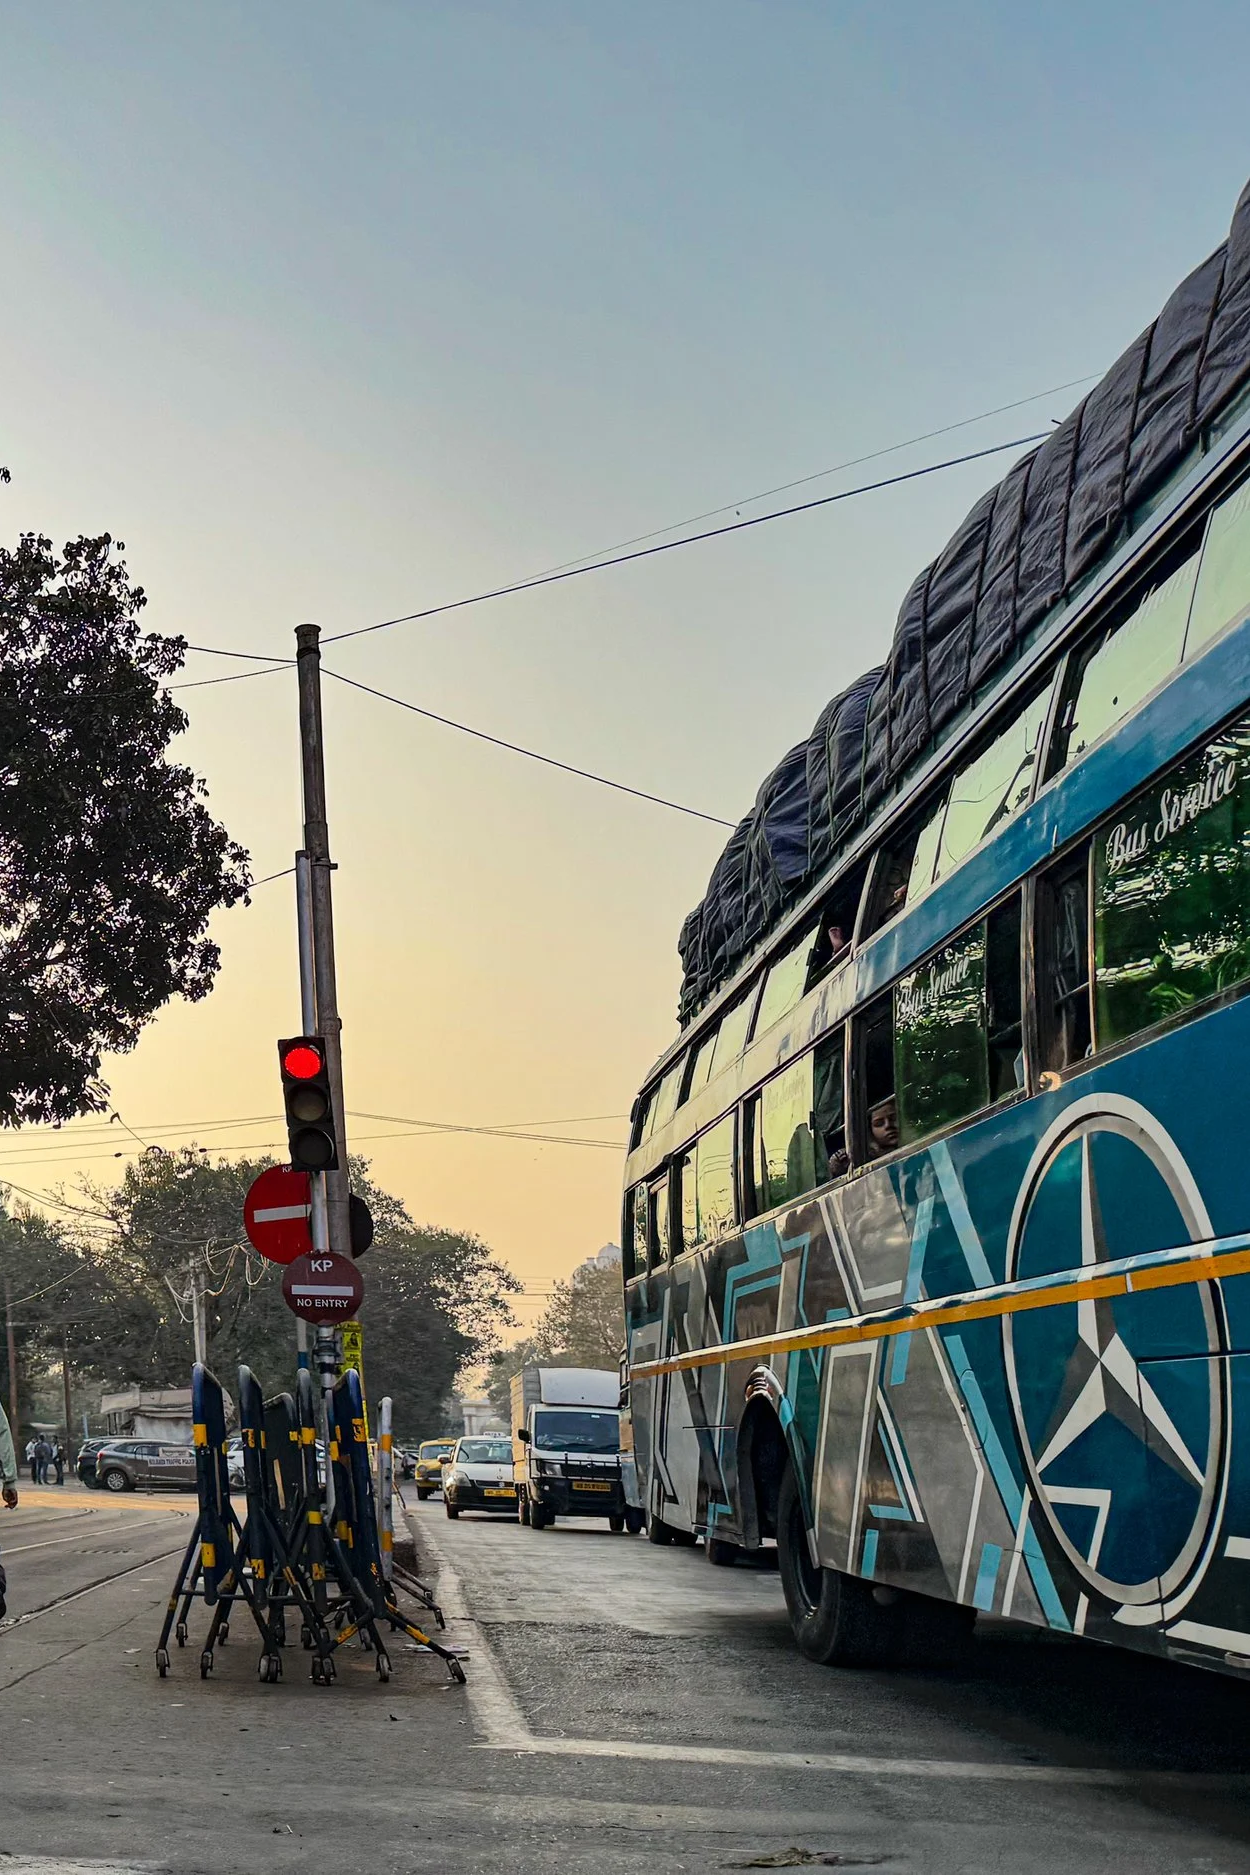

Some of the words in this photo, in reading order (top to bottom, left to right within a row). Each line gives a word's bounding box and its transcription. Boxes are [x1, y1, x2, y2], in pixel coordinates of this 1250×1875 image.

[1106, 822, 1149, 875] Bus
[1154, 760, 1237, 843] Service
[311, 1259, 333, 1272] KP
[297, 1298, 312, 1307] NO
[314, 1299, 348, 1308] ENTRY
